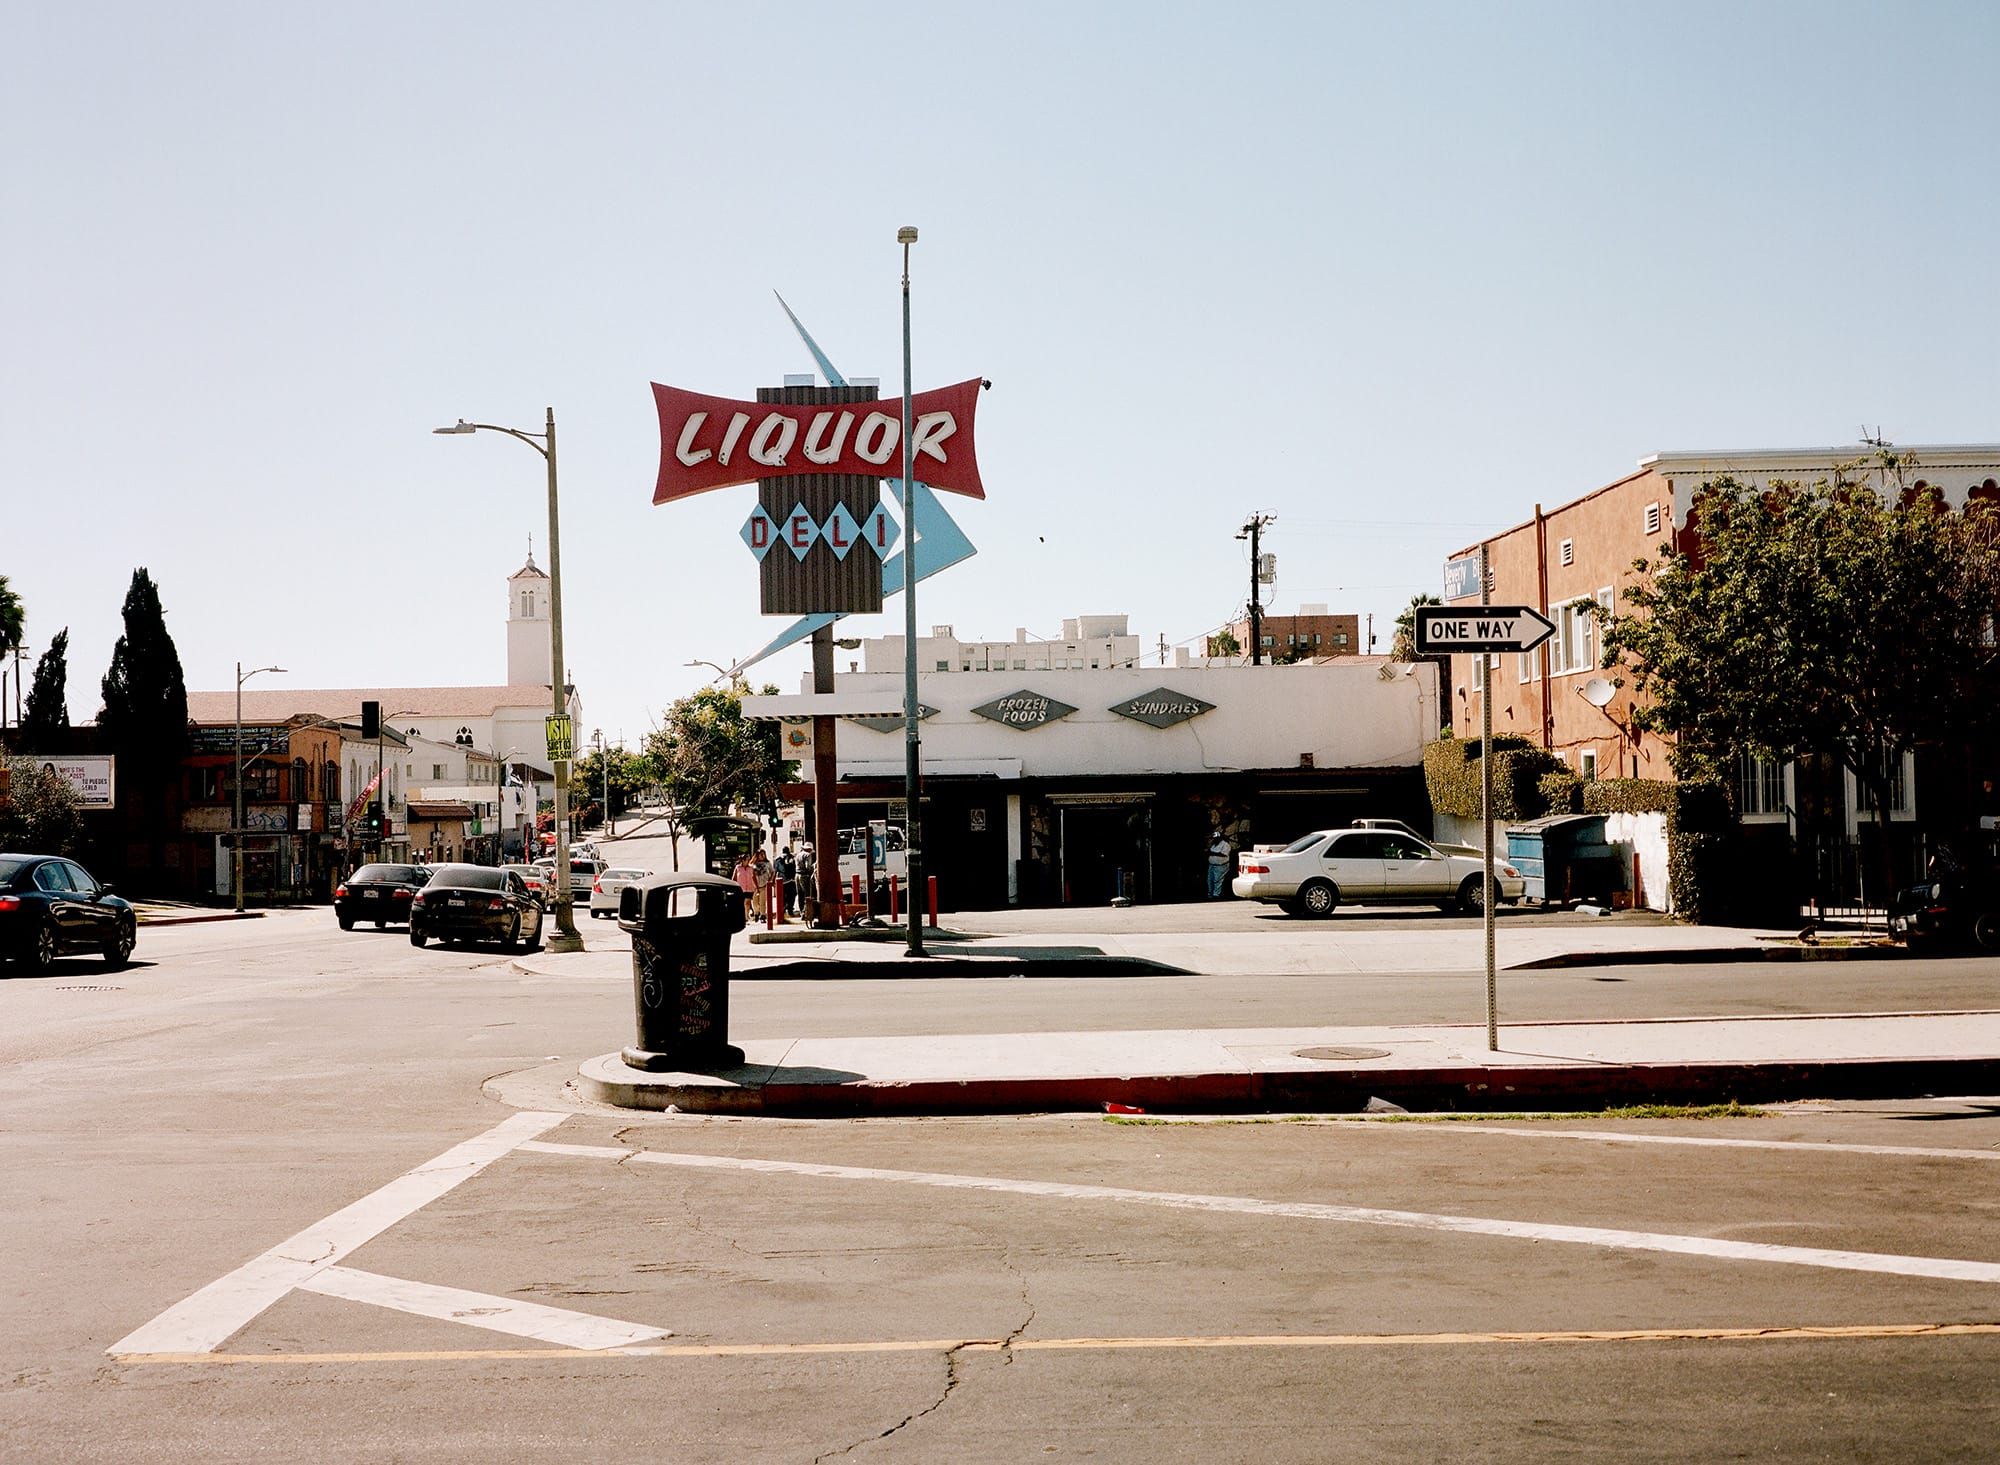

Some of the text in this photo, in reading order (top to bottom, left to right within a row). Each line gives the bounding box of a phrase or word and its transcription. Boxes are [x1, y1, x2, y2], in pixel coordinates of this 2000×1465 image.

[676, 411, 958, 467] LIQUOR
[751, 514, 885, 548] DELI
[1445, 562, 1466, 585] Beverly
[1431, 621, 1514, 639] ONE WAY
[997, 698, 1049, 711] FROZEN
[1130, 701, 1202, 716] SUNDRIES
[1002, 710, 1047, 723] FOODS
